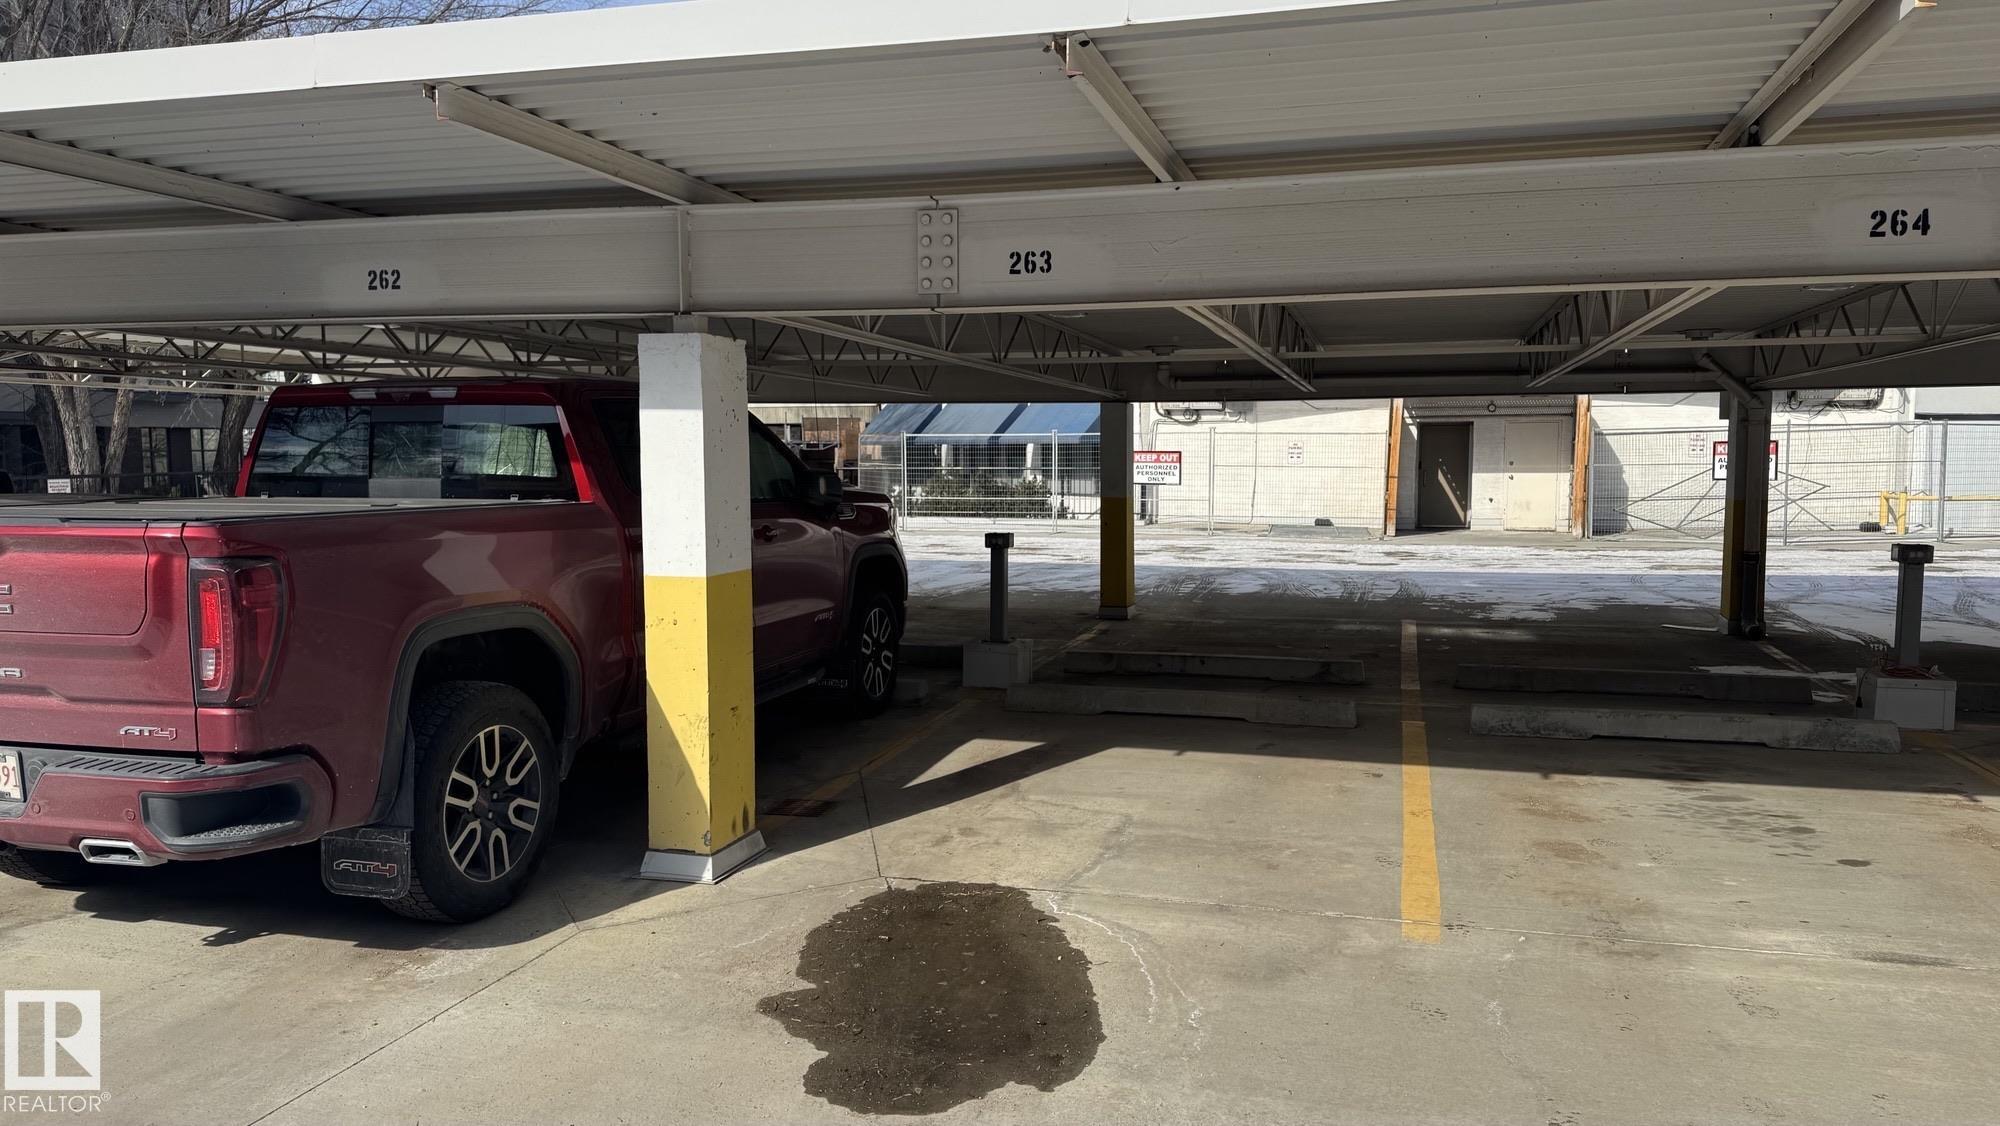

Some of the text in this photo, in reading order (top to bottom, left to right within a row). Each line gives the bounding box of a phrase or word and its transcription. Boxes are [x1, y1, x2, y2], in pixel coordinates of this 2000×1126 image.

[1870, 208, 1930, 237] 264
[1009, 250, 1052, 275] 263
[368, 269, 400, 290] 262
[1135, 454, 1179, 462] KEEP OUT
[120, 726, 177, 741] AT4
[0, 765, 20, 788] 91
